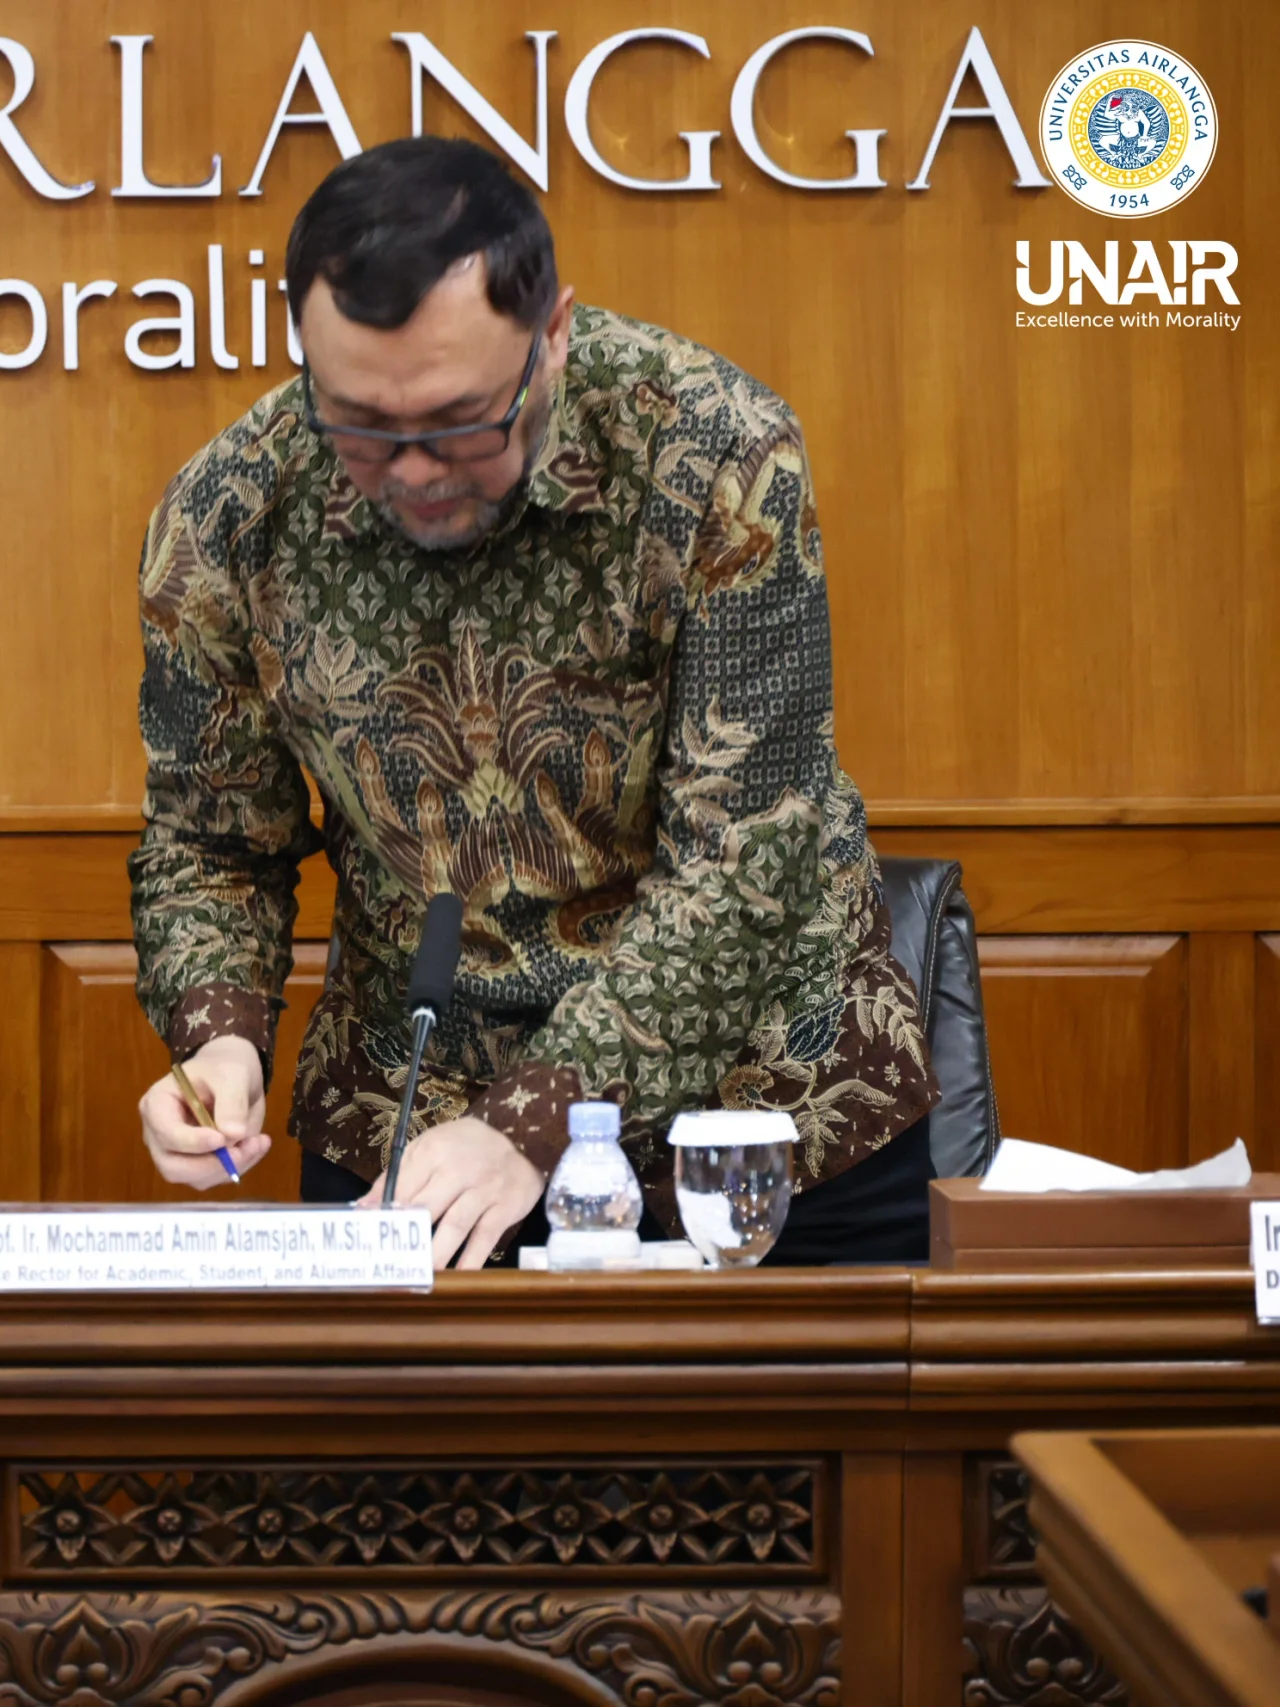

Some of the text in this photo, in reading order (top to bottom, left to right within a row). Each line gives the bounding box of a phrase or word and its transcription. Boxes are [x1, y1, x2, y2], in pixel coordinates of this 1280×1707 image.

[23, 1225, 39, 1253] Ir.
[47, 1224, 164, 1253] Mochammad
[172, 1222, 217, 1252] Amin
[225, 1221, 315, 1260] Alamsjah,
[379, 1220, 426, 1251] Ph.D.
[18, 1265, 71, 1282] Rector
[78, 1265, 99, 1281] for
[106, 1265, 193, 1286] Academic,
[199, 1264, 268, 1286] Student,
[274, 1264, 303, 1281] and
[310, 1263, 366, 1281] Alumni
[372, 1263, 427, 1281] Affairs
